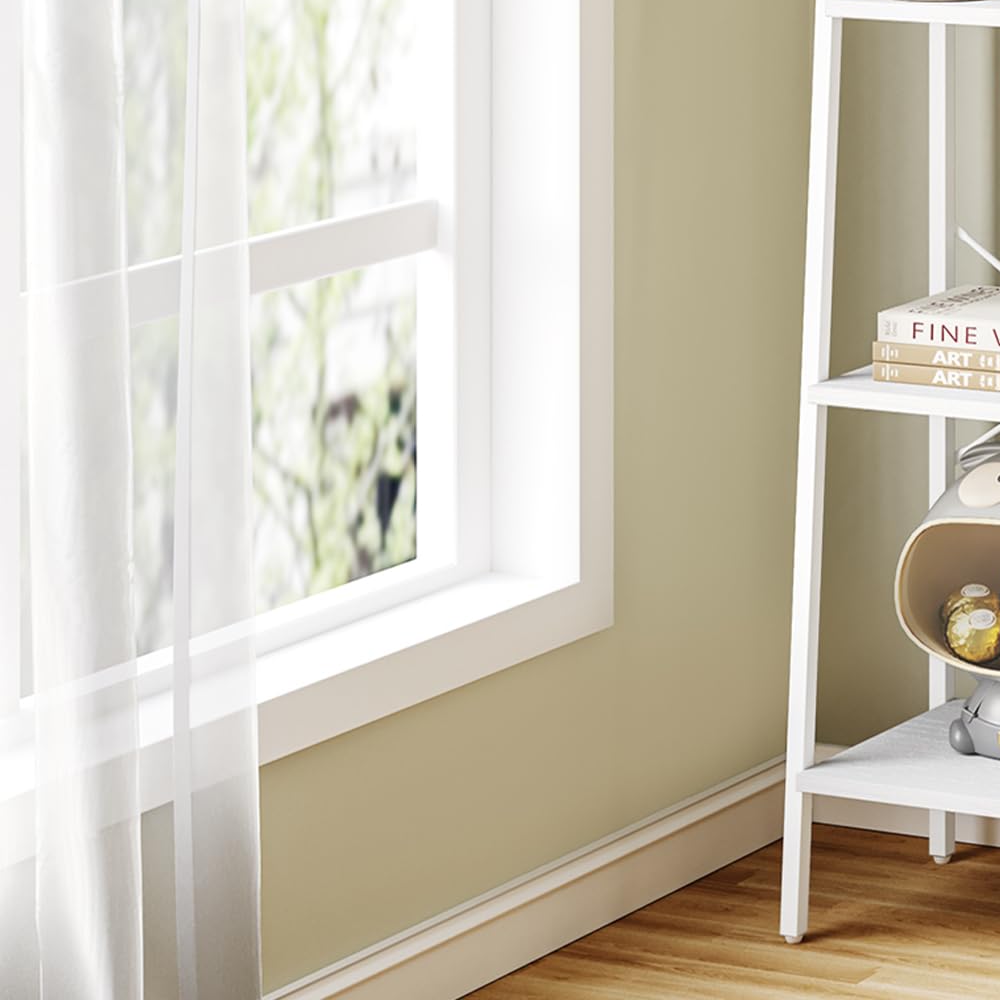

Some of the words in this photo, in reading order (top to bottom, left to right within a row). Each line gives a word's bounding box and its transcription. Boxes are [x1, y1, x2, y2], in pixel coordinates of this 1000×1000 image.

[911, 321, 978, 345] FINE
[932, 350, 973, 368] ART
[932, 370, 973, 387] ART
